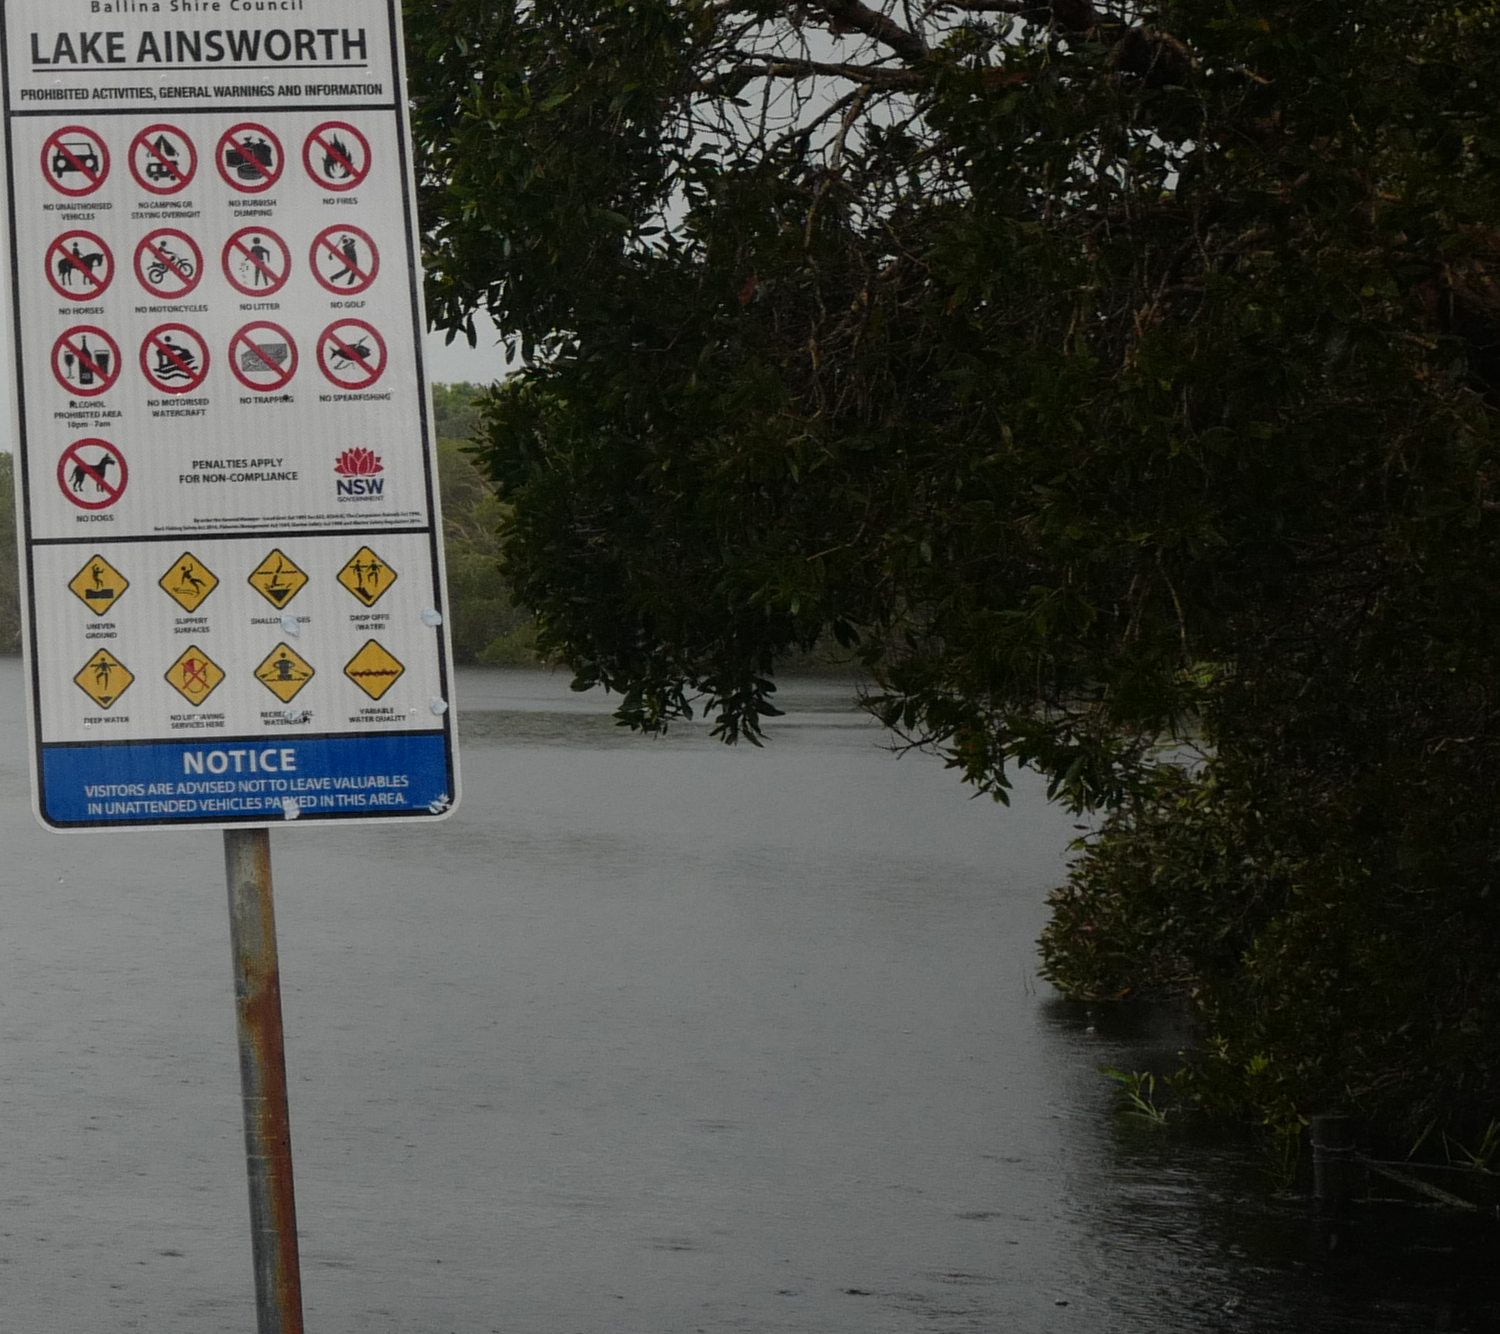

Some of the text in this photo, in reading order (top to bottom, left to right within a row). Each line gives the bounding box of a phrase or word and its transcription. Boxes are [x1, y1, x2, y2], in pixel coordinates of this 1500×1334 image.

[90, 0, 160, 14] Ballina
[170, 0, 221, 12] Shire
[31, 28, 367, 65] LAKE AINSWORTH
[21, 84, 382, 101] PROHIBITED ACTIVITIES, GENERAL WARNINGS AND INFORMATION
[242, 199, 276, 207] RUBBISH
[61, 213, 95, 221] VEHICLES
[161, 211, 201, 219] OVERNIGHT
[234, 209, 272, 217] DUMPING
[73, 307, 104, 315] HORSES
[149, 305, 208, 313] MOTORCYCLES
[333, 393, 391, 402] SPEARFISHING
[161, 398, 209, 406] MOTORISED
[54, 410, 122, 419] PROHIBITED AREA
[152, 409, 206, 417] WATERCRAFT
[67, 421, 88, 429] 10pm
[192, 458, 283, 469] PENALTIES APPLY
[179, 471, 298, 483] FOR NON-COMPLIANCE
[337, 479, 384, 495] NSW
[337, 495, 384, 503] GOVERNMENT
[90, 514, 114, 522] DOGS
[174, 626, 210, 634] SURFACES
[171, 721, 205, 729] SERVICES
[183, 748, 297, 774] NOTICE
[85, 775, 409, 798] VISITORS ARE ADVISED NOT TO LEAVE VALUABLES
[88, 803, 102, 815] IN
[105, 800, 197, 814] UNATTENDED
[200, 797, 262, 811] VEHICLES
[320, 795, 335, 807] IN
[337, 794, 366, 806] THIS
[369, 793, 407, 805] AREA.
